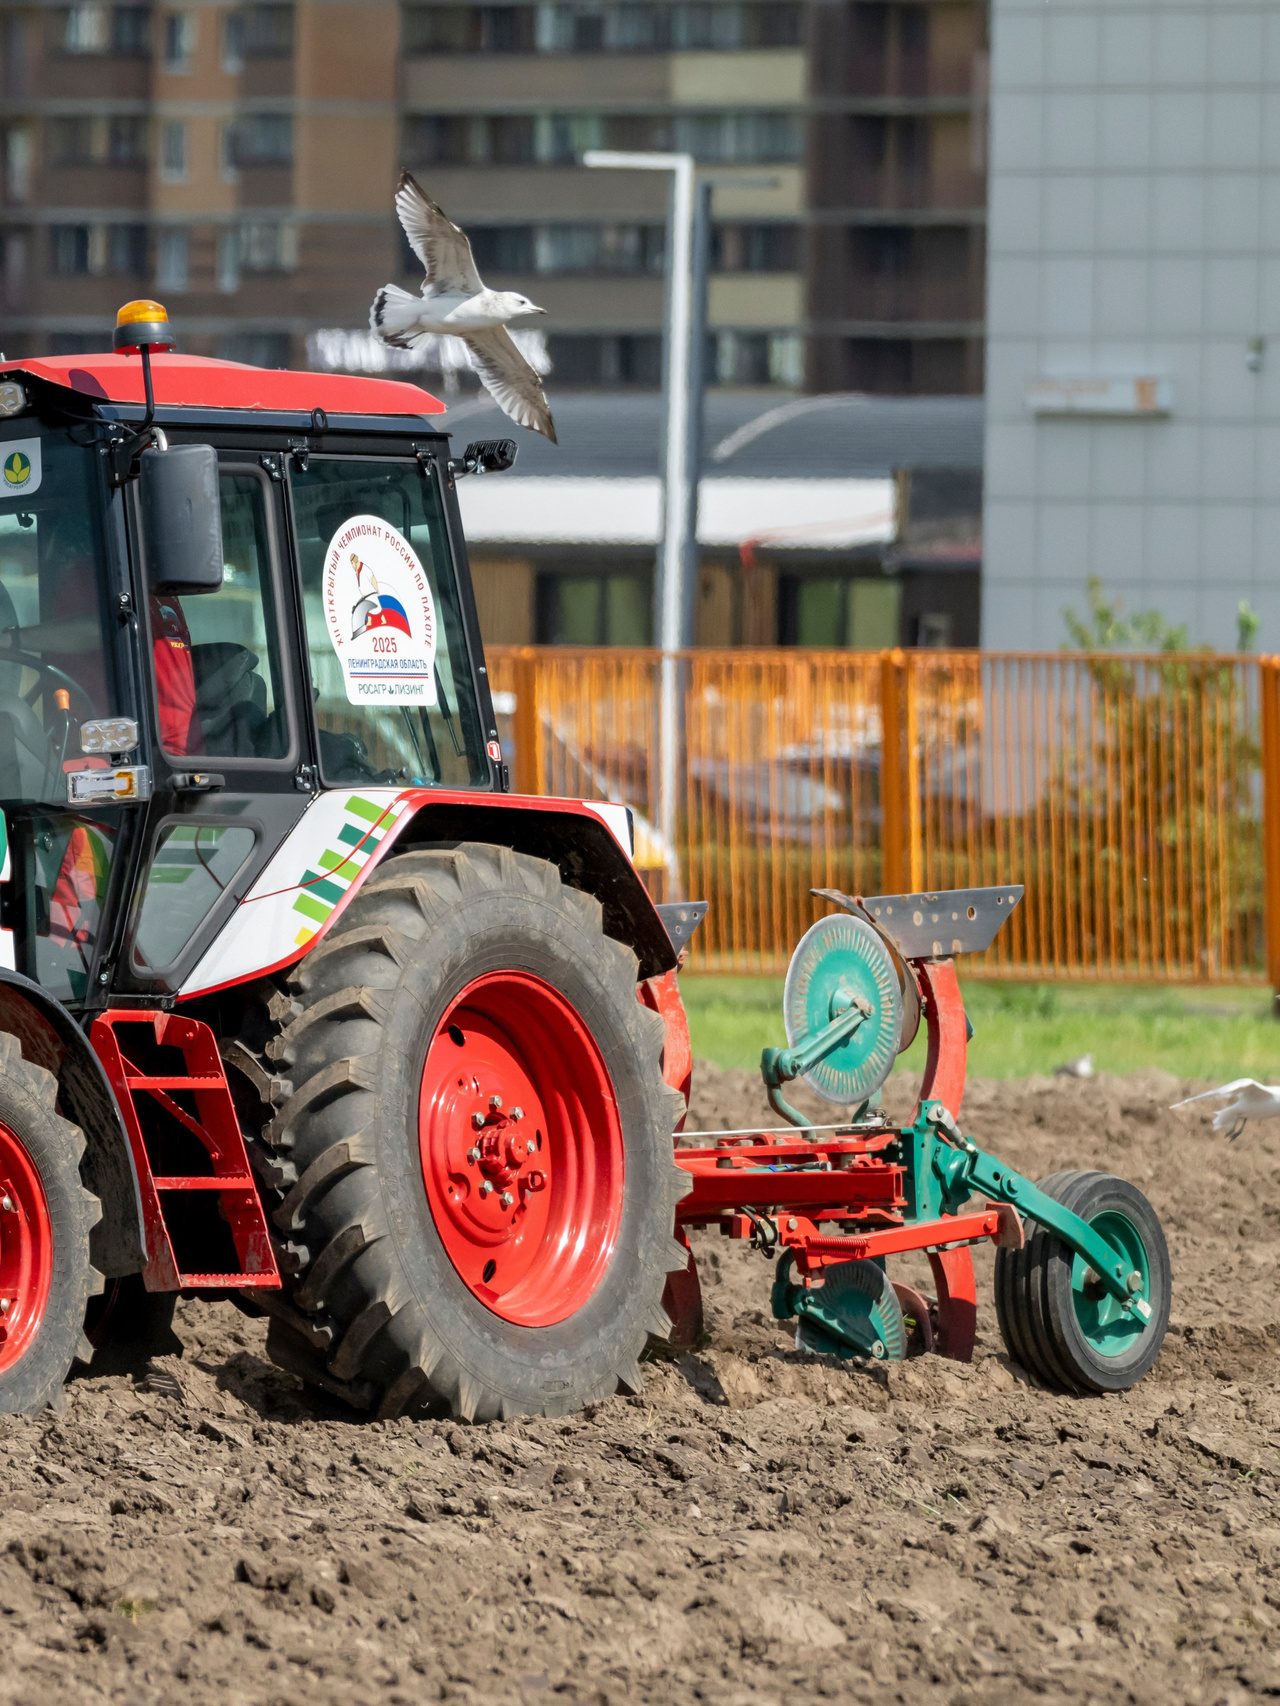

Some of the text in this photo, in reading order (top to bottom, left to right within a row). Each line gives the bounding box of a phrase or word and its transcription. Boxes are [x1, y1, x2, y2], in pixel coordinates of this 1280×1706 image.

[328, 550, 341, 623] ОТКРЫТЫЙ
[338, 524, 382, 550] ЧЕМПИОНАТ
[385, 531, 415, 571] РОССИИ
[414, 574, 424, 591] ПО
[421, 596, 432, 648] ПАХОТЕ
[372, 637, 398, 653] 2025
[348, 658, 428, 669] ЛЕНИНГРАДСКАЯ ОБЛАСТЬ
